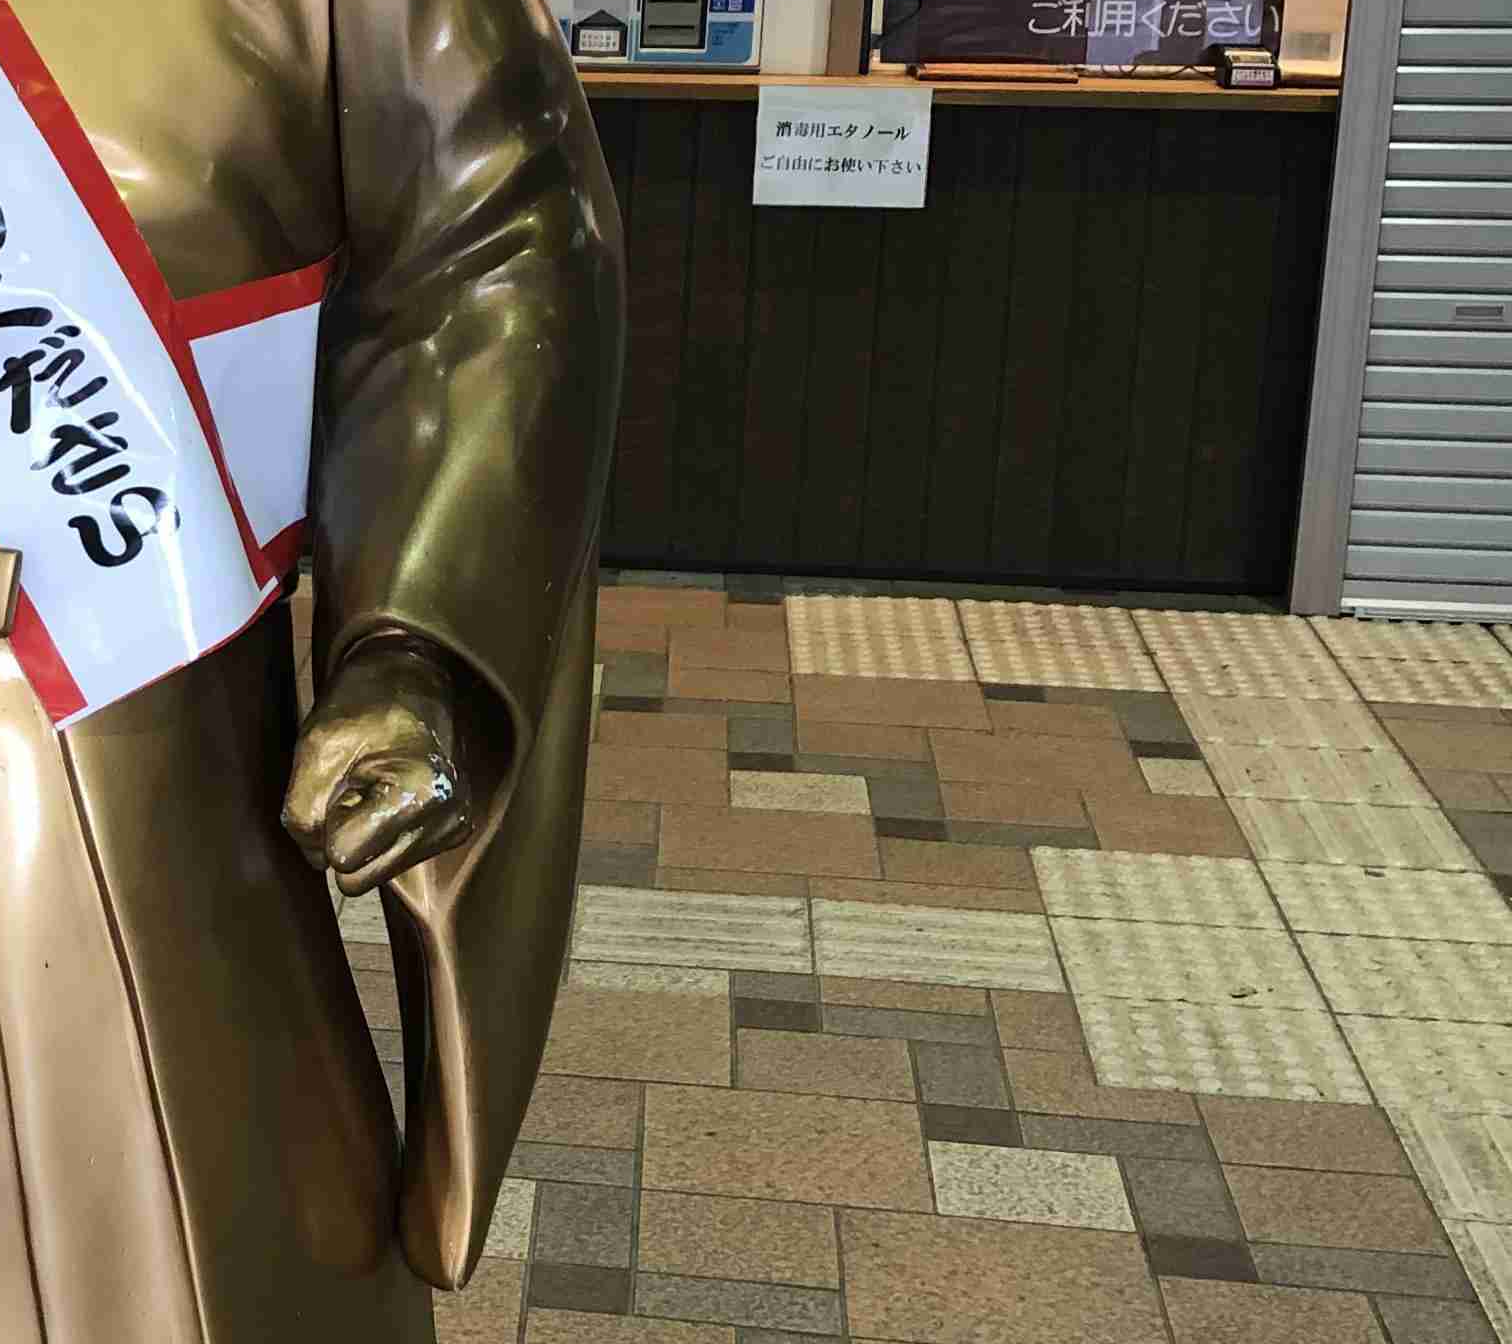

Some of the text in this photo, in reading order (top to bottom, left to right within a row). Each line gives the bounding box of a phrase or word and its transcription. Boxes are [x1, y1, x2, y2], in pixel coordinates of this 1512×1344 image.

[1028, 0, 1280, 38] ご利用ください
[776, 121, 910, 140] 消毒用エタノール
[760, 155, 921, 175] ご自由にお使い下さい
